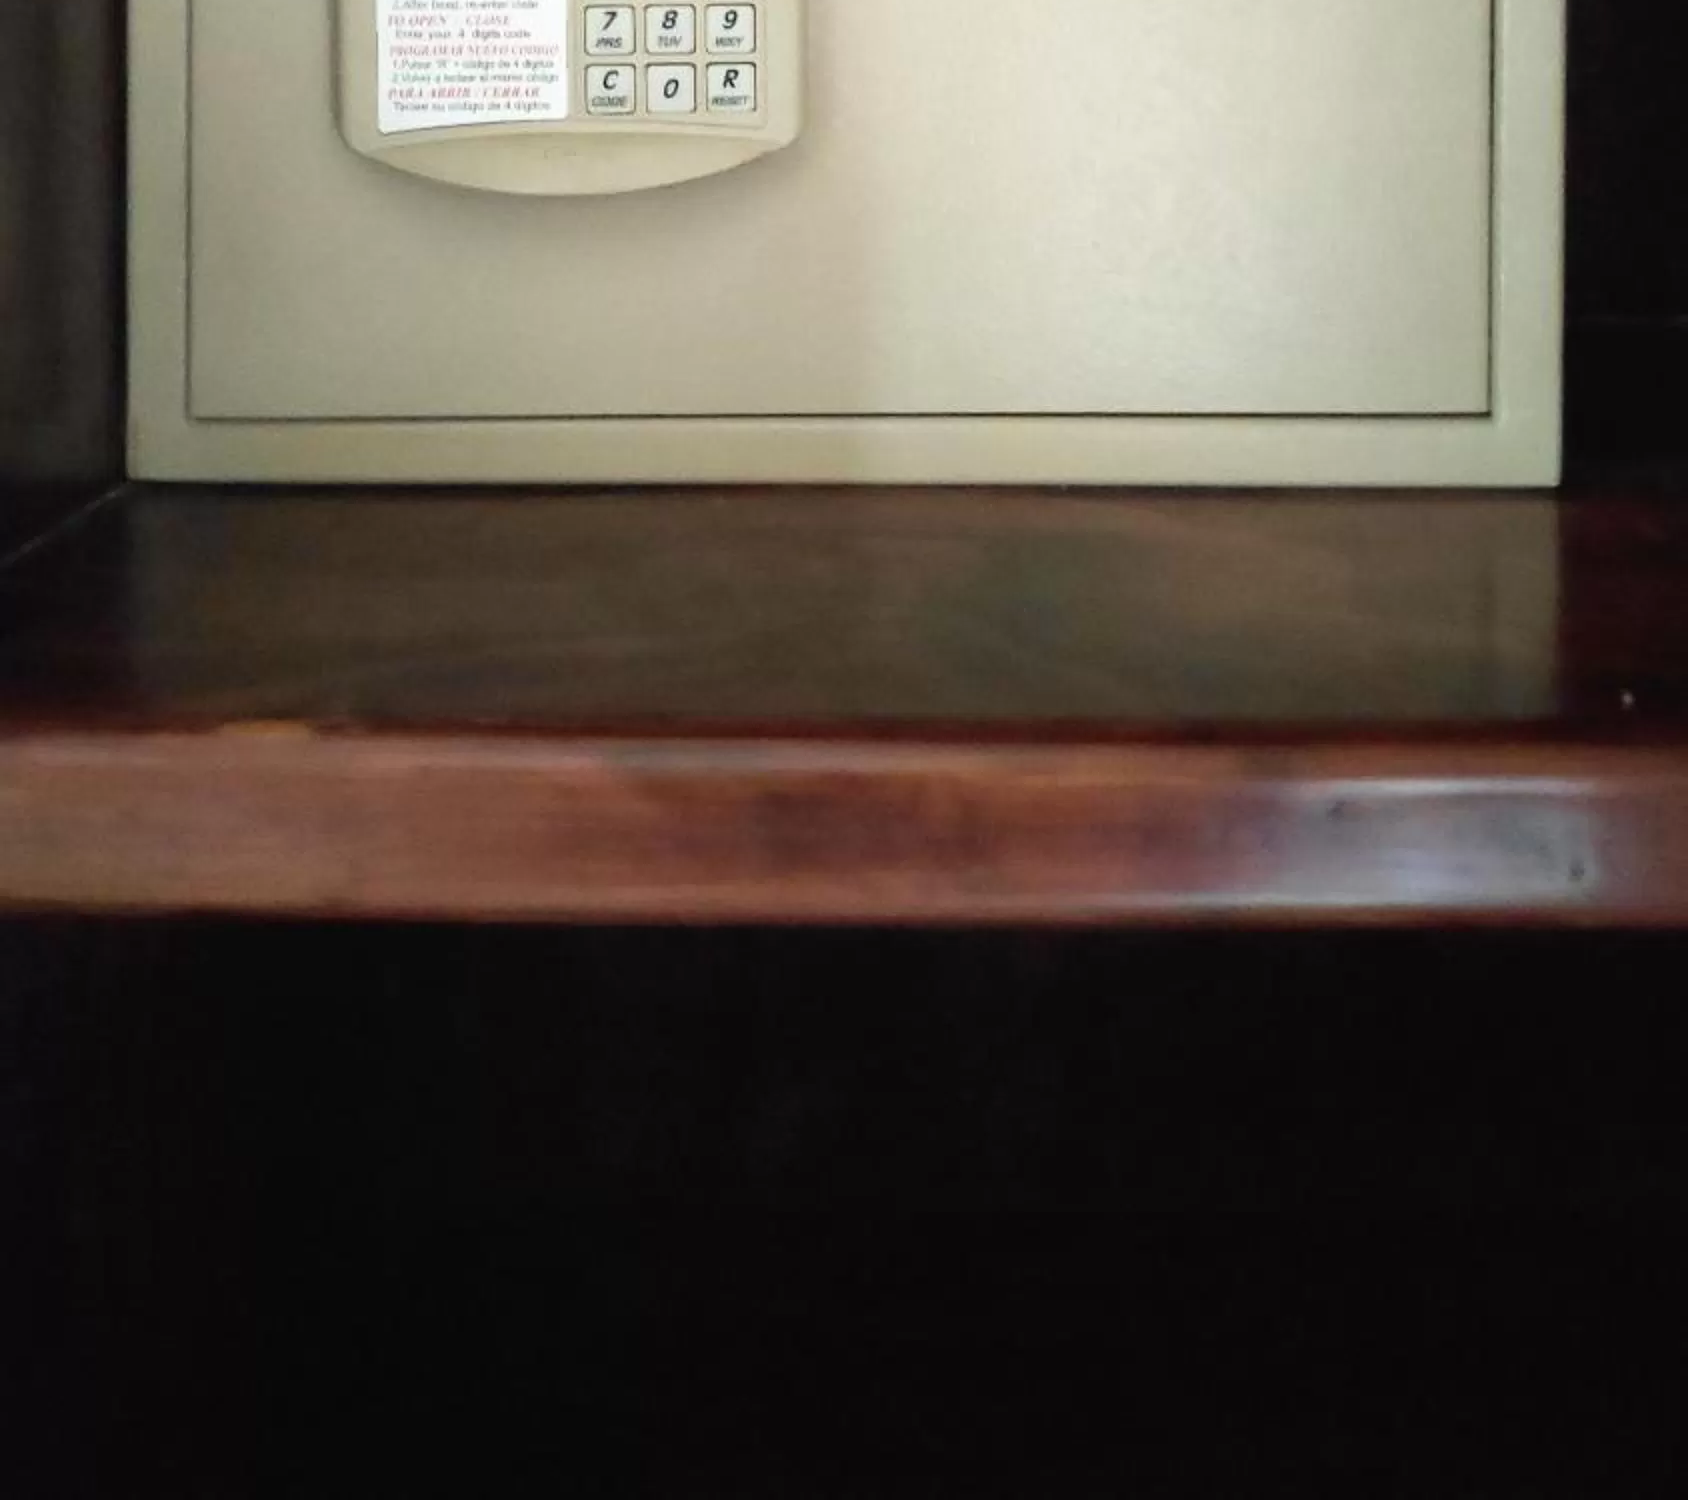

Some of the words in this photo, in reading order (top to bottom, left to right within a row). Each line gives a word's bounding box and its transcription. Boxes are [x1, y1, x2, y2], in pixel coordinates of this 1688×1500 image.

[603, 12, 617, 31] 7
[662, 10, 678, 30] 8
[722, 9, 738, 30] 9
[428, 31, 451, 41] your
[595, 37, 623, 48] PRS
[657, 37, 682, 48] TUV
[715, 36, 744, 48] WXY
[603, 70, 619, 91] C
[723, 69, 739, 89] R
[388, 87, 423, 100] PARA
[483, 86, 540, 98] CERRAR
[663, 79, 680, 99] 0
[592, 96, 627, 107] CODE
[711, 95, 750, 106] RESET
